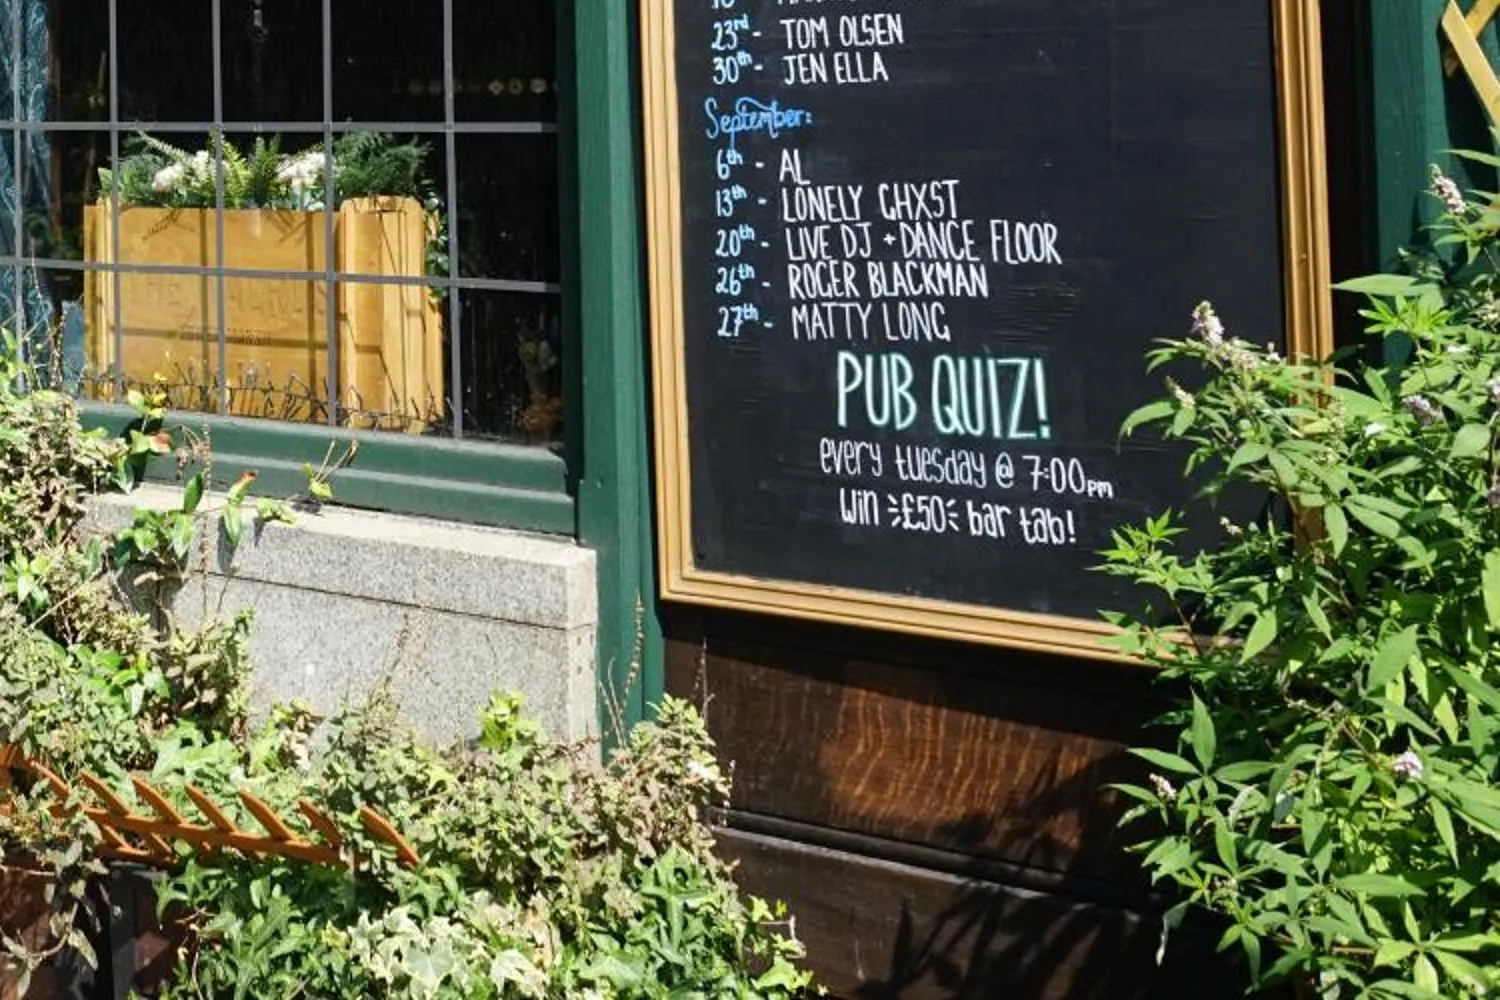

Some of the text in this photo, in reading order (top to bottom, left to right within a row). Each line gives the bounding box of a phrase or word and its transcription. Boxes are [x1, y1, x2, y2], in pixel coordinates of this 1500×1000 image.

[780, 17, 830, 50] TOM
[839, 13, 904, 47] OLSEN
[781, 53, 828, 86] JEN
[835, 51, 889, 84] ELLA
[779, 148, 811, 185] AL
[781, 185, 863, 223] LONELY
[785, 223, 833, 262] LIVE
[841, 222, 873, 260] DJ
[900, 220, 980, 262] DANCE
[989, 219, 1062, 265] FLOOR
[787, 261, 861, 300] ROGER
[868, 261, 989, 299] BLACKMAN
[791, 302, 873, 341] MATTY
[881, 302, 951, 342] LONG
[836, 350, 1050, 439] PUB QUIZ!
[820, 437, 883, 477] every
[895, 444, 987, 488] tuesday
[995, 452, 1015, 489] @
[967, 500, 1012, 539] bar
